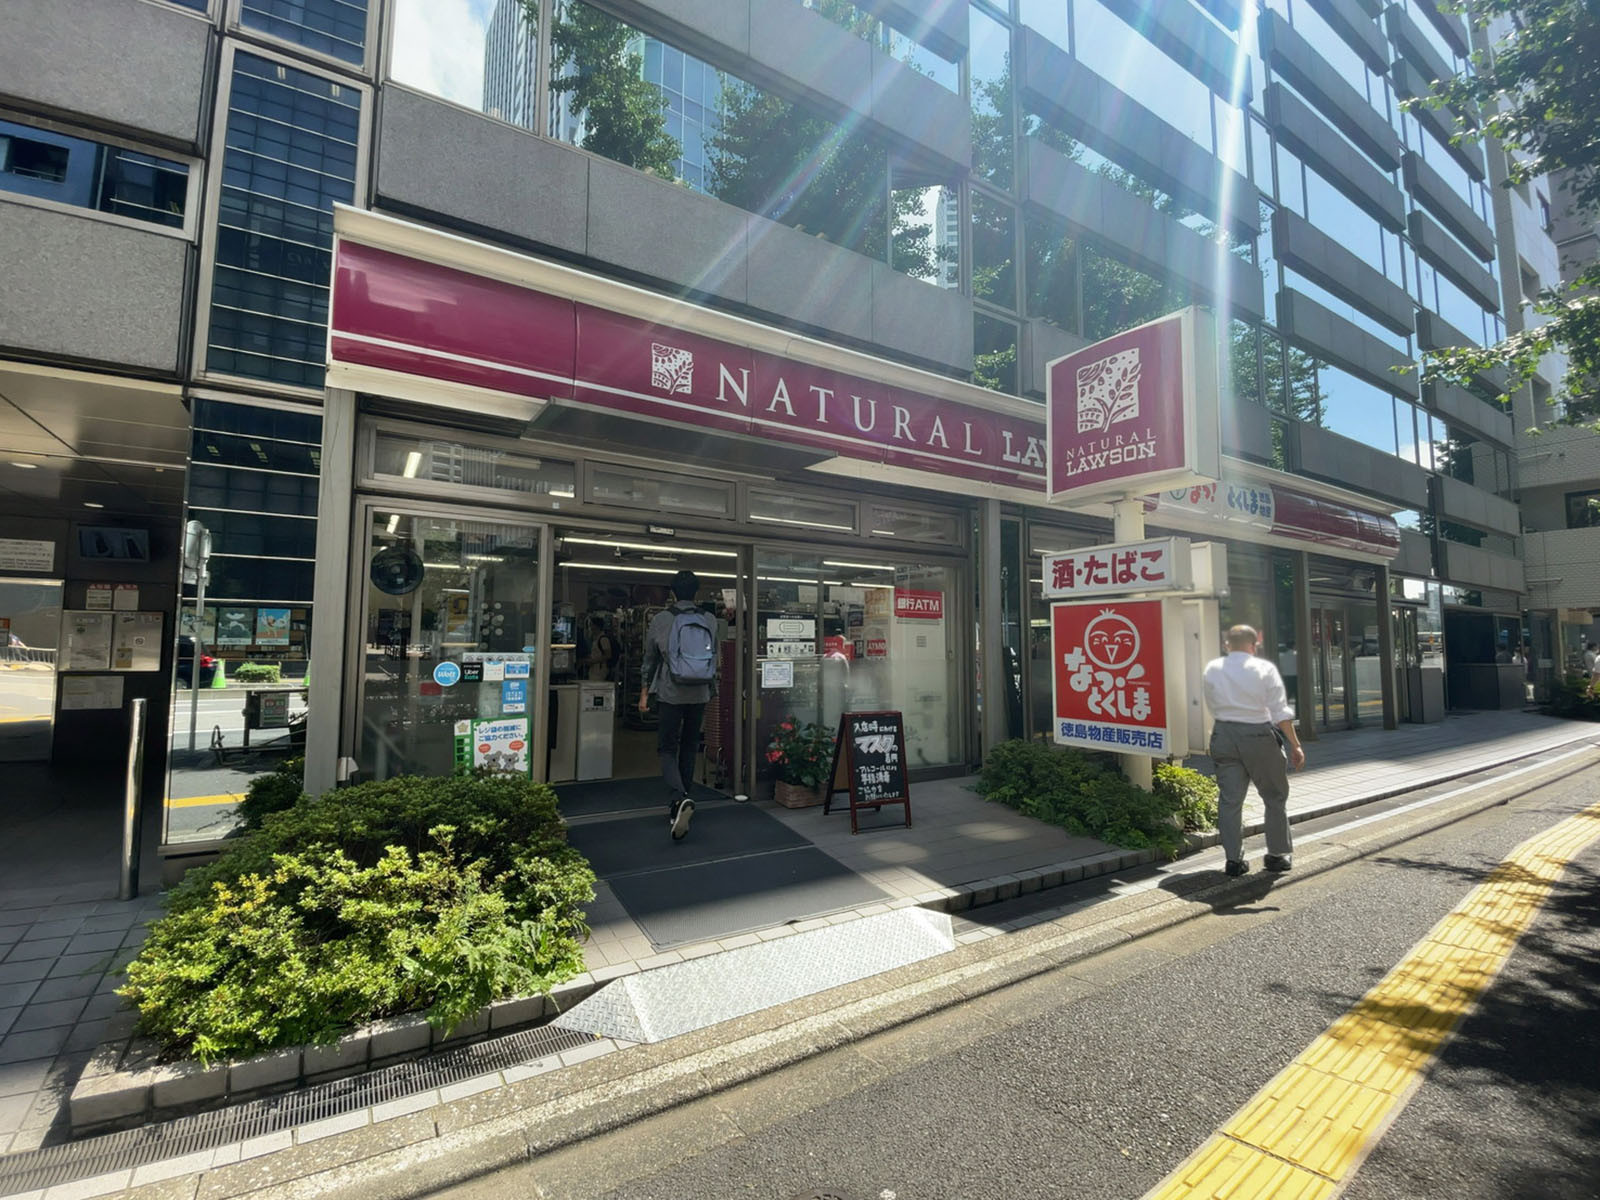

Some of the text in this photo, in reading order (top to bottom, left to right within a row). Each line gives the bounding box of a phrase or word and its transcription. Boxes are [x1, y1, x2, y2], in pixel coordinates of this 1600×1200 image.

[716, 360, 984, 457] NATURAL
[1066, 428, 1157, 460] NATURAL
[1066, 441, 1157, 477] LAWSON
[1052, 548, 1166, 590] 酒・たばこ
[897, 597, 940, 613] 銀行ATM
[1086, 686, 1152, 722] とくしま
[1060, 721, 1164, 750] 徳島物産販売店
